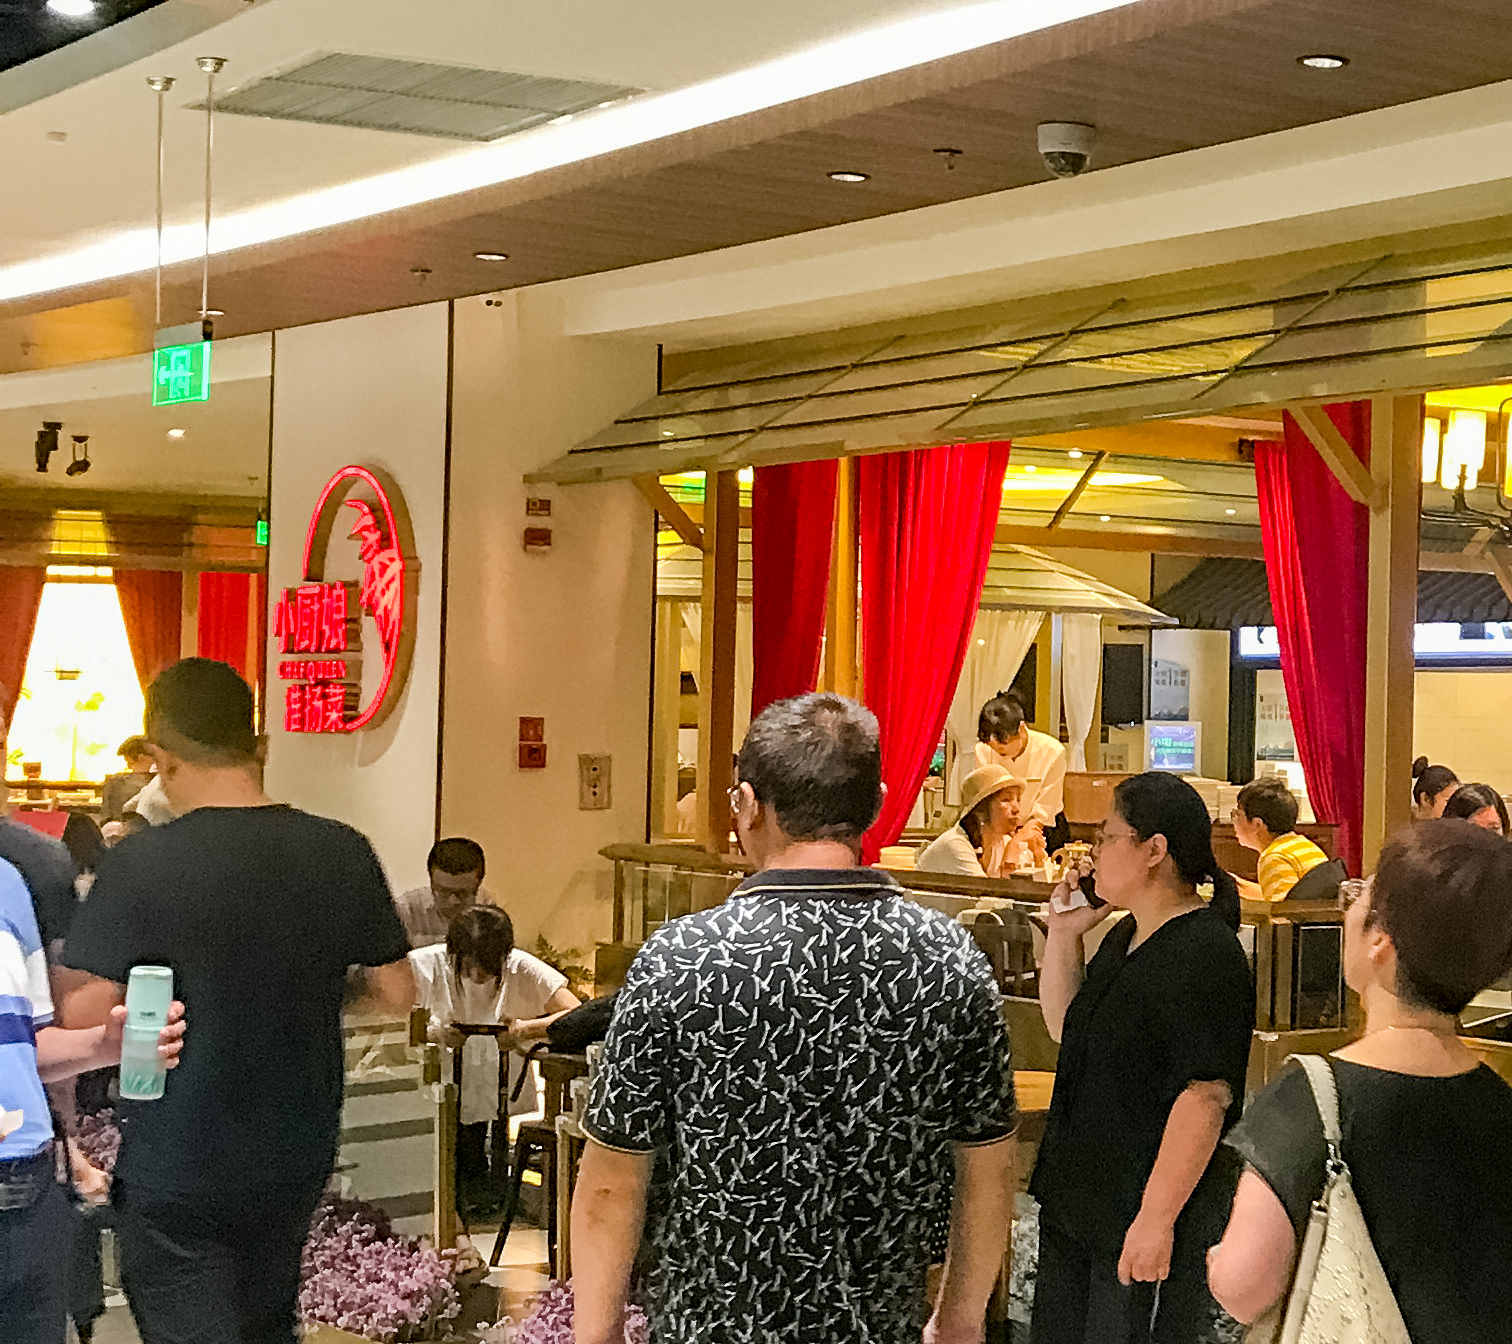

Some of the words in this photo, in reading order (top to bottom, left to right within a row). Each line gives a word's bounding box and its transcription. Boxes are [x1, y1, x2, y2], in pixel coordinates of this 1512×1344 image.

[272, 581, 347, 653] 小厨娘
[284, 683, 347, 733] 淮扬菜
